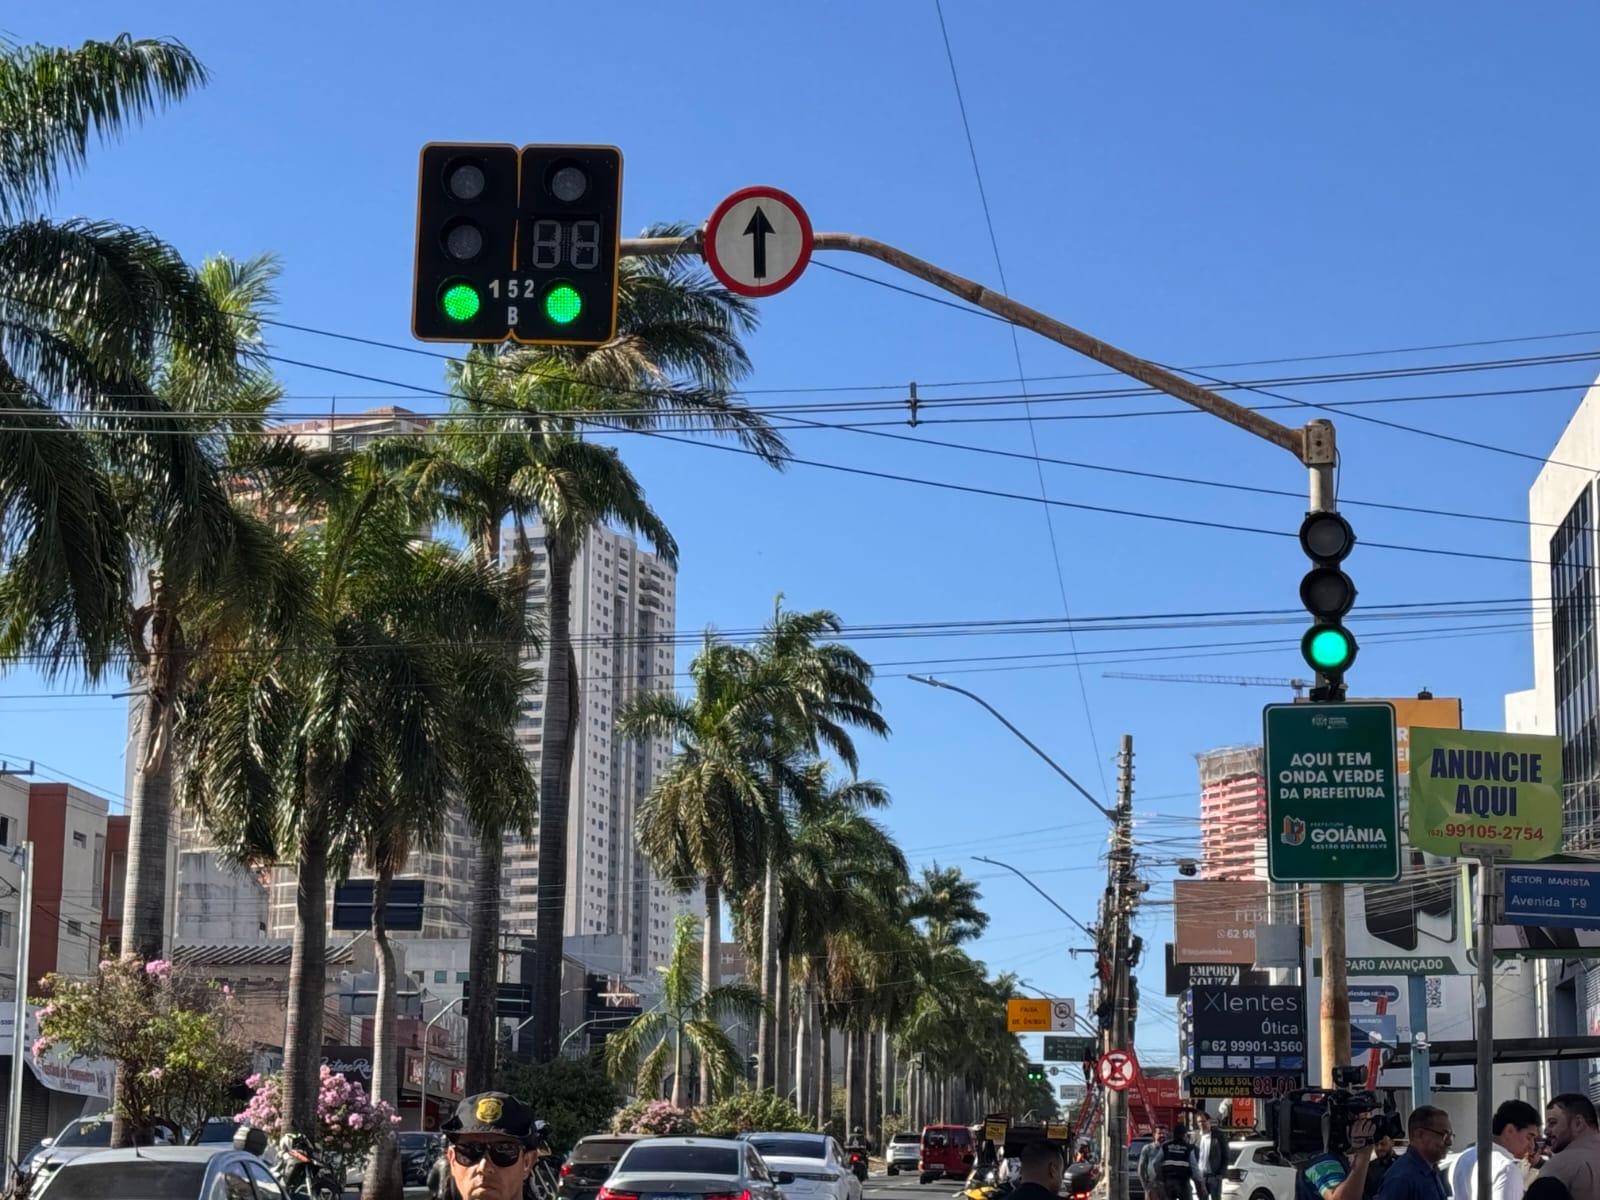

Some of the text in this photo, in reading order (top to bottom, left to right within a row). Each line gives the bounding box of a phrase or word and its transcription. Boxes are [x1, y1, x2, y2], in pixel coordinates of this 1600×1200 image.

[507, 306, 518, 325] B
[1290, 752, 1371, 767] AQUI TEM
[1430, 748, 1542, 783] ANUNCIE
[1279, 769, 1385, 783] ONDA VERDE
[1280, 787, 1385, 799] DA PREFEITURA
[1455, 784, 1517, 818] AQUI
[1311, 825, 1387, 843] GOIÂNIA
[1445, 823, 1544, 841] 99105-2754
[1511, 875, 1591, 887] SETOR MARISTA
[1511, 894, 1588, 909] Avenida T-9
[1378, 959, 1444, 973] AVANÇADO
[1204, 992, 1298, 1012] Xlentes
[1261, 1018, 1298, 1035] Ótica
[1211, 1040, 1303, 1052] 62 99901-3560
[1225, 1077, 1236, 1086] DE
[1237, 1077, 1252, 1086] SOL
[1193, 1086, 1250, 1097] OU ARMAÇÕES
